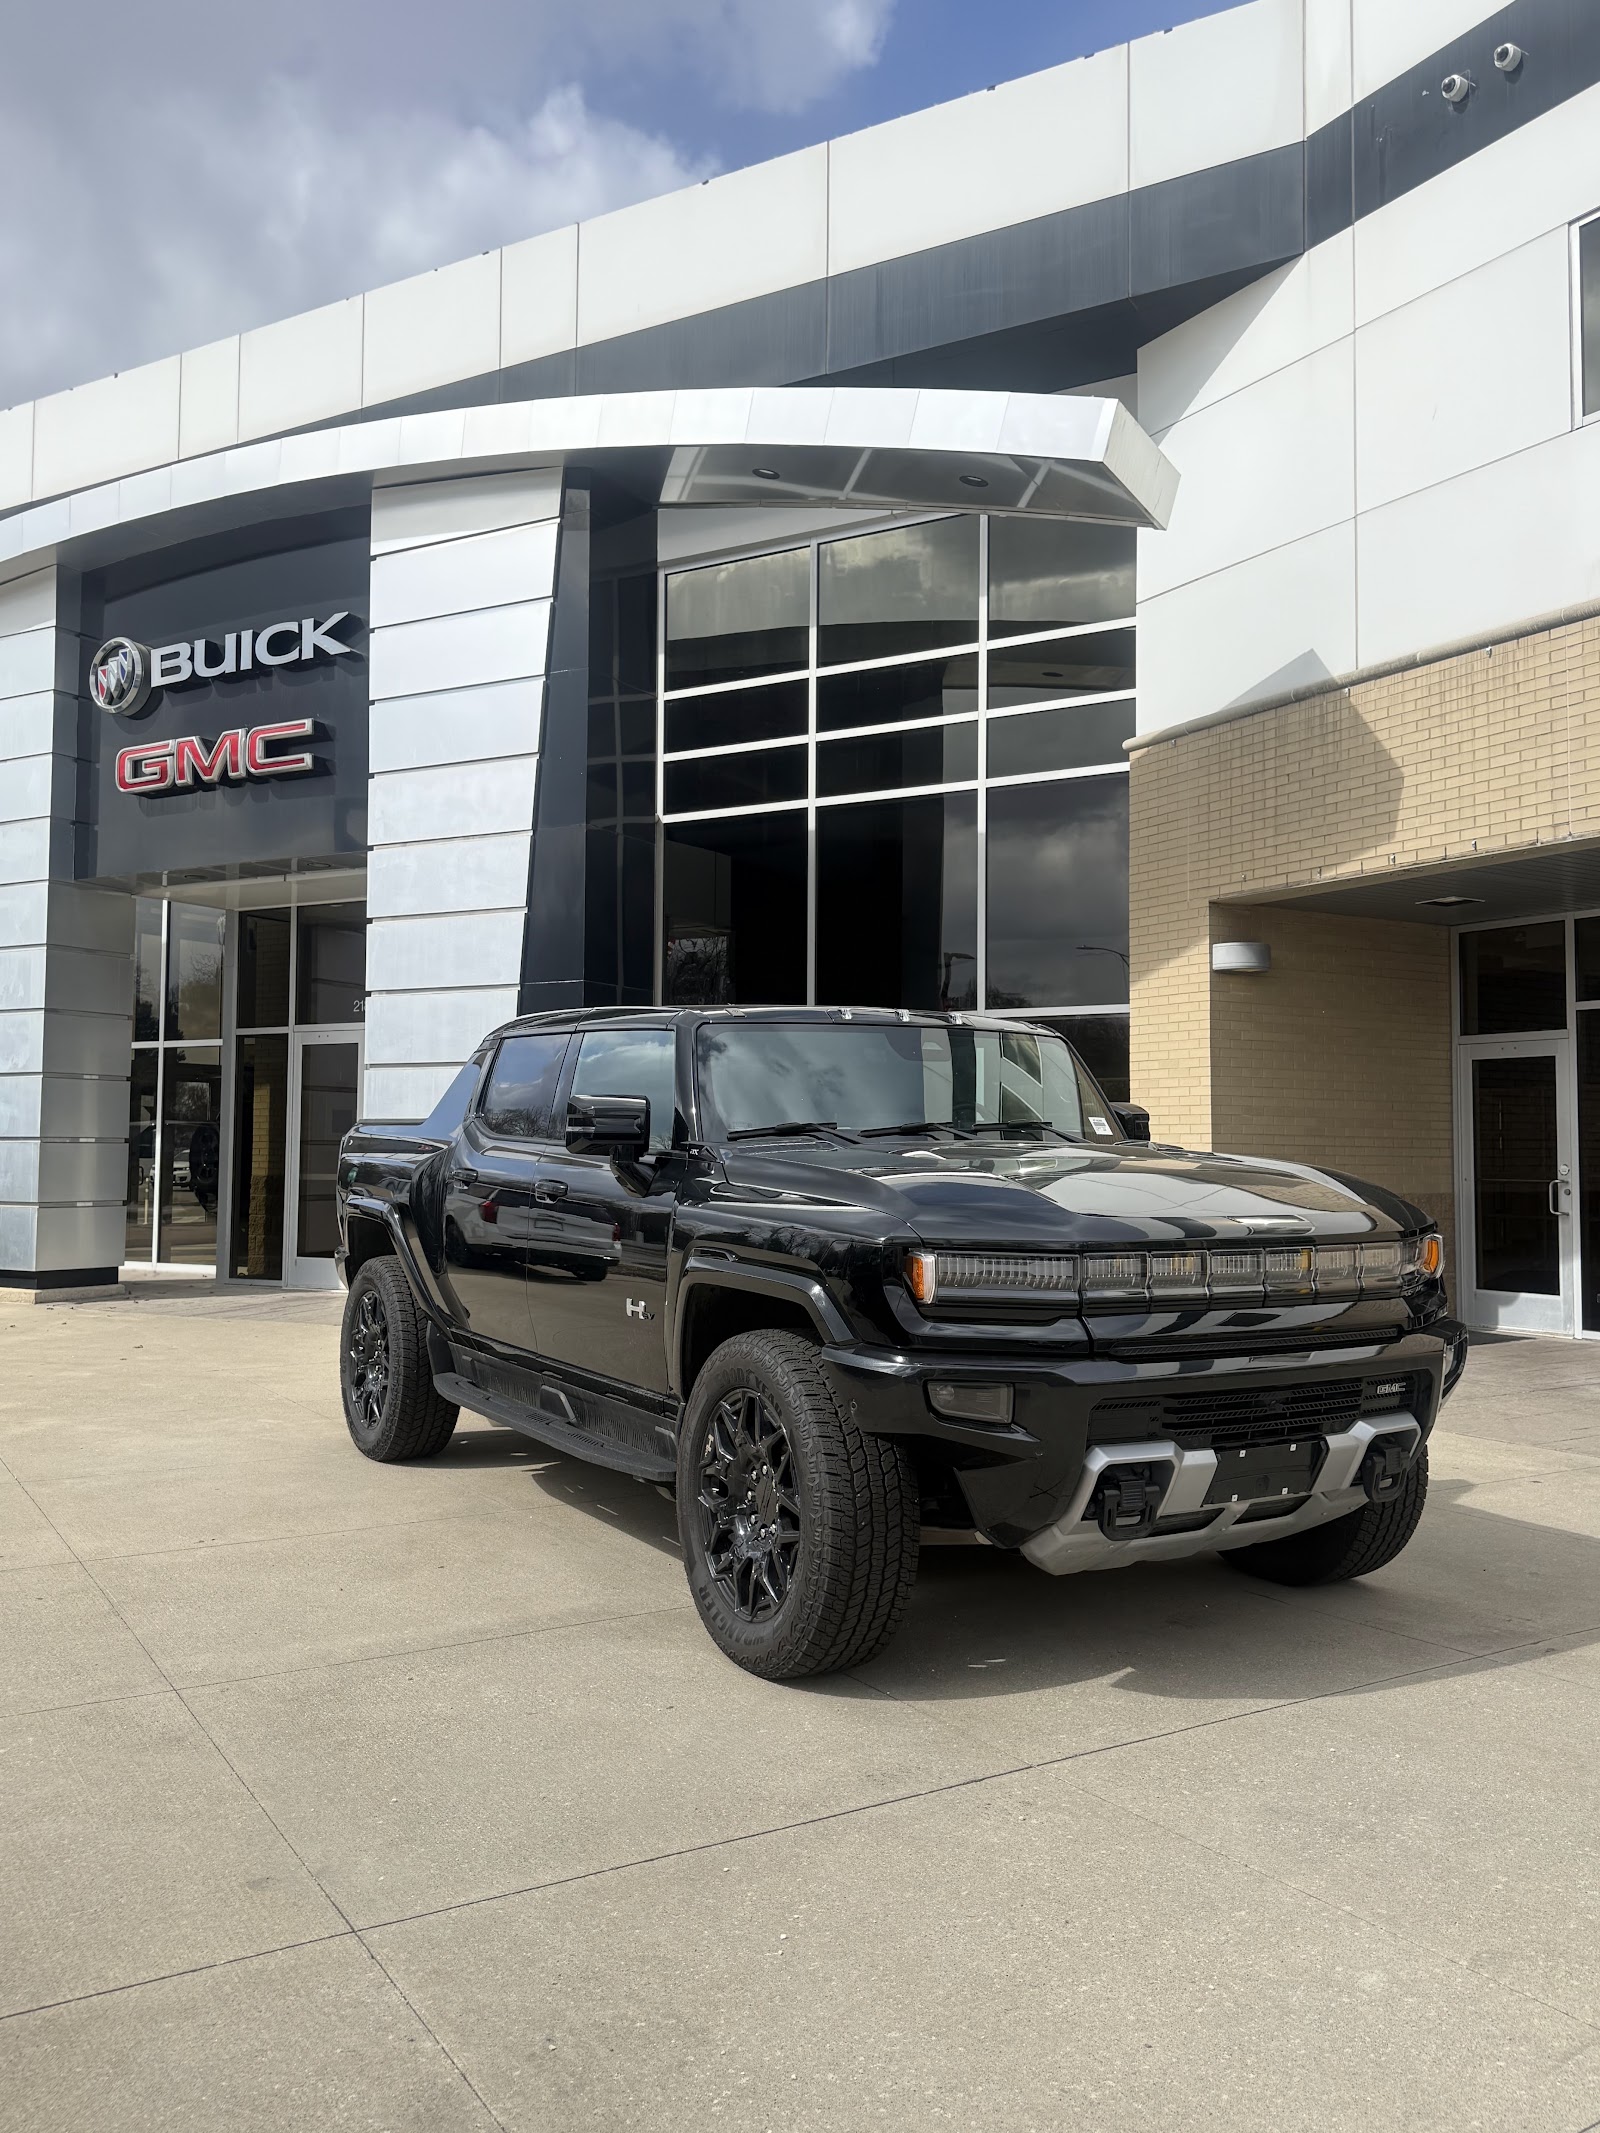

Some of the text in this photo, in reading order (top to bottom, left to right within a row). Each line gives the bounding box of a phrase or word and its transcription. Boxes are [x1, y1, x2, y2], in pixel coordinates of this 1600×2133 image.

[150, 611, 351, 688] BUICK
[115, 717, 314, 793] GMC
[353, 999, 366, 1013] 21
[1376, 1382, 1406, 1394] GMC
